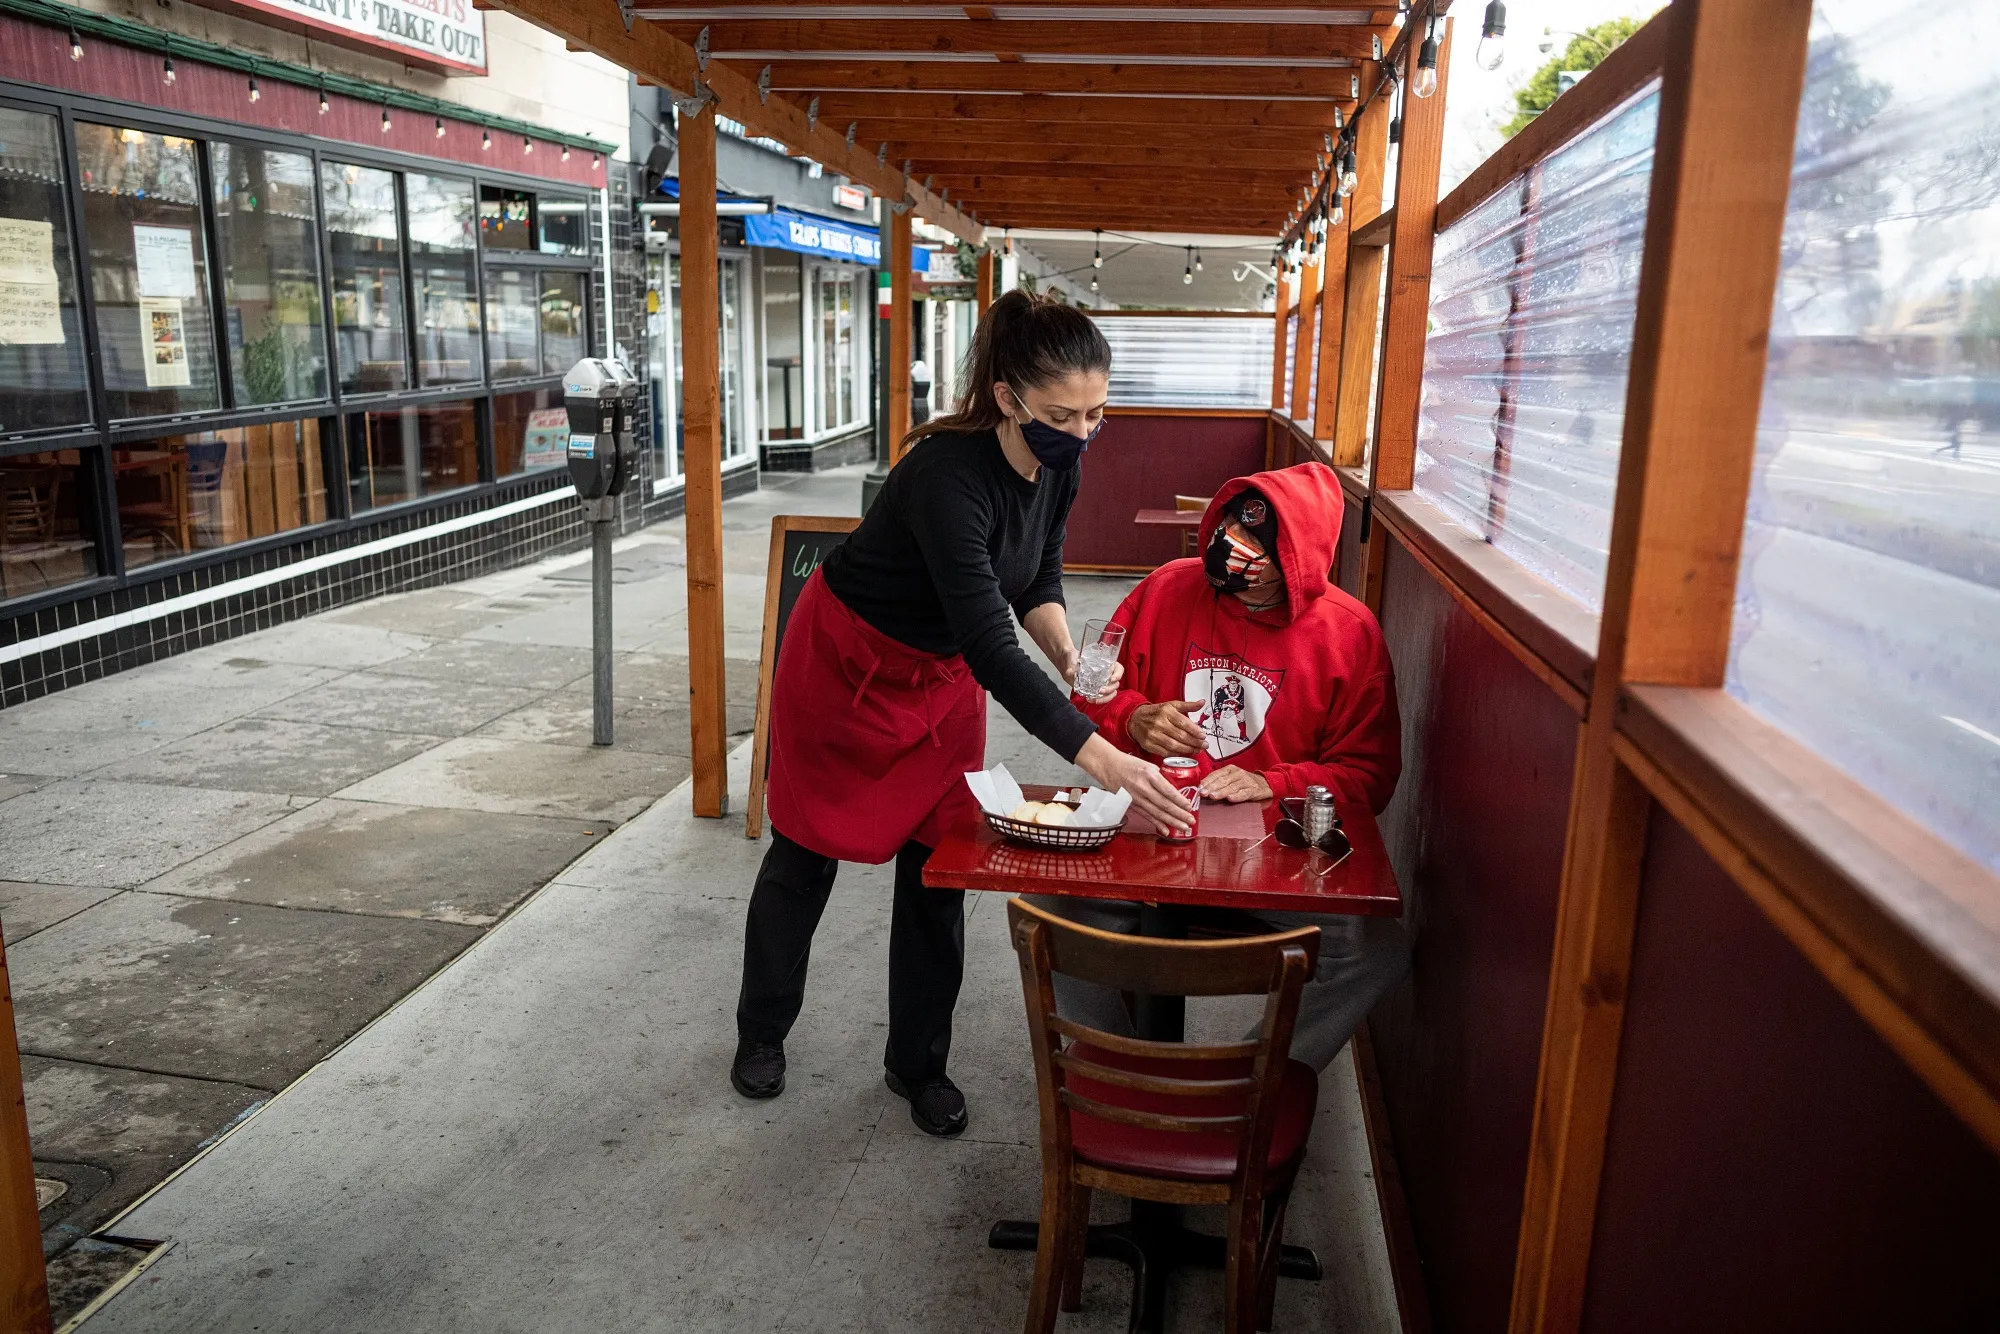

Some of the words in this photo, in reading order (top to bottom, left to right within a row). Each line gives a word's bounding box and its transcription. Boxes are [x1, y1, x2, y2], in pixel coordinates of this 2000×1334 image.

[373, 1, 435, 46] TAKE
[441, 24, 480, 60] OUT
[1189, 658, 1229, 669] BOSTON
[1232, 662, 1277, 693] PATRIOTS
